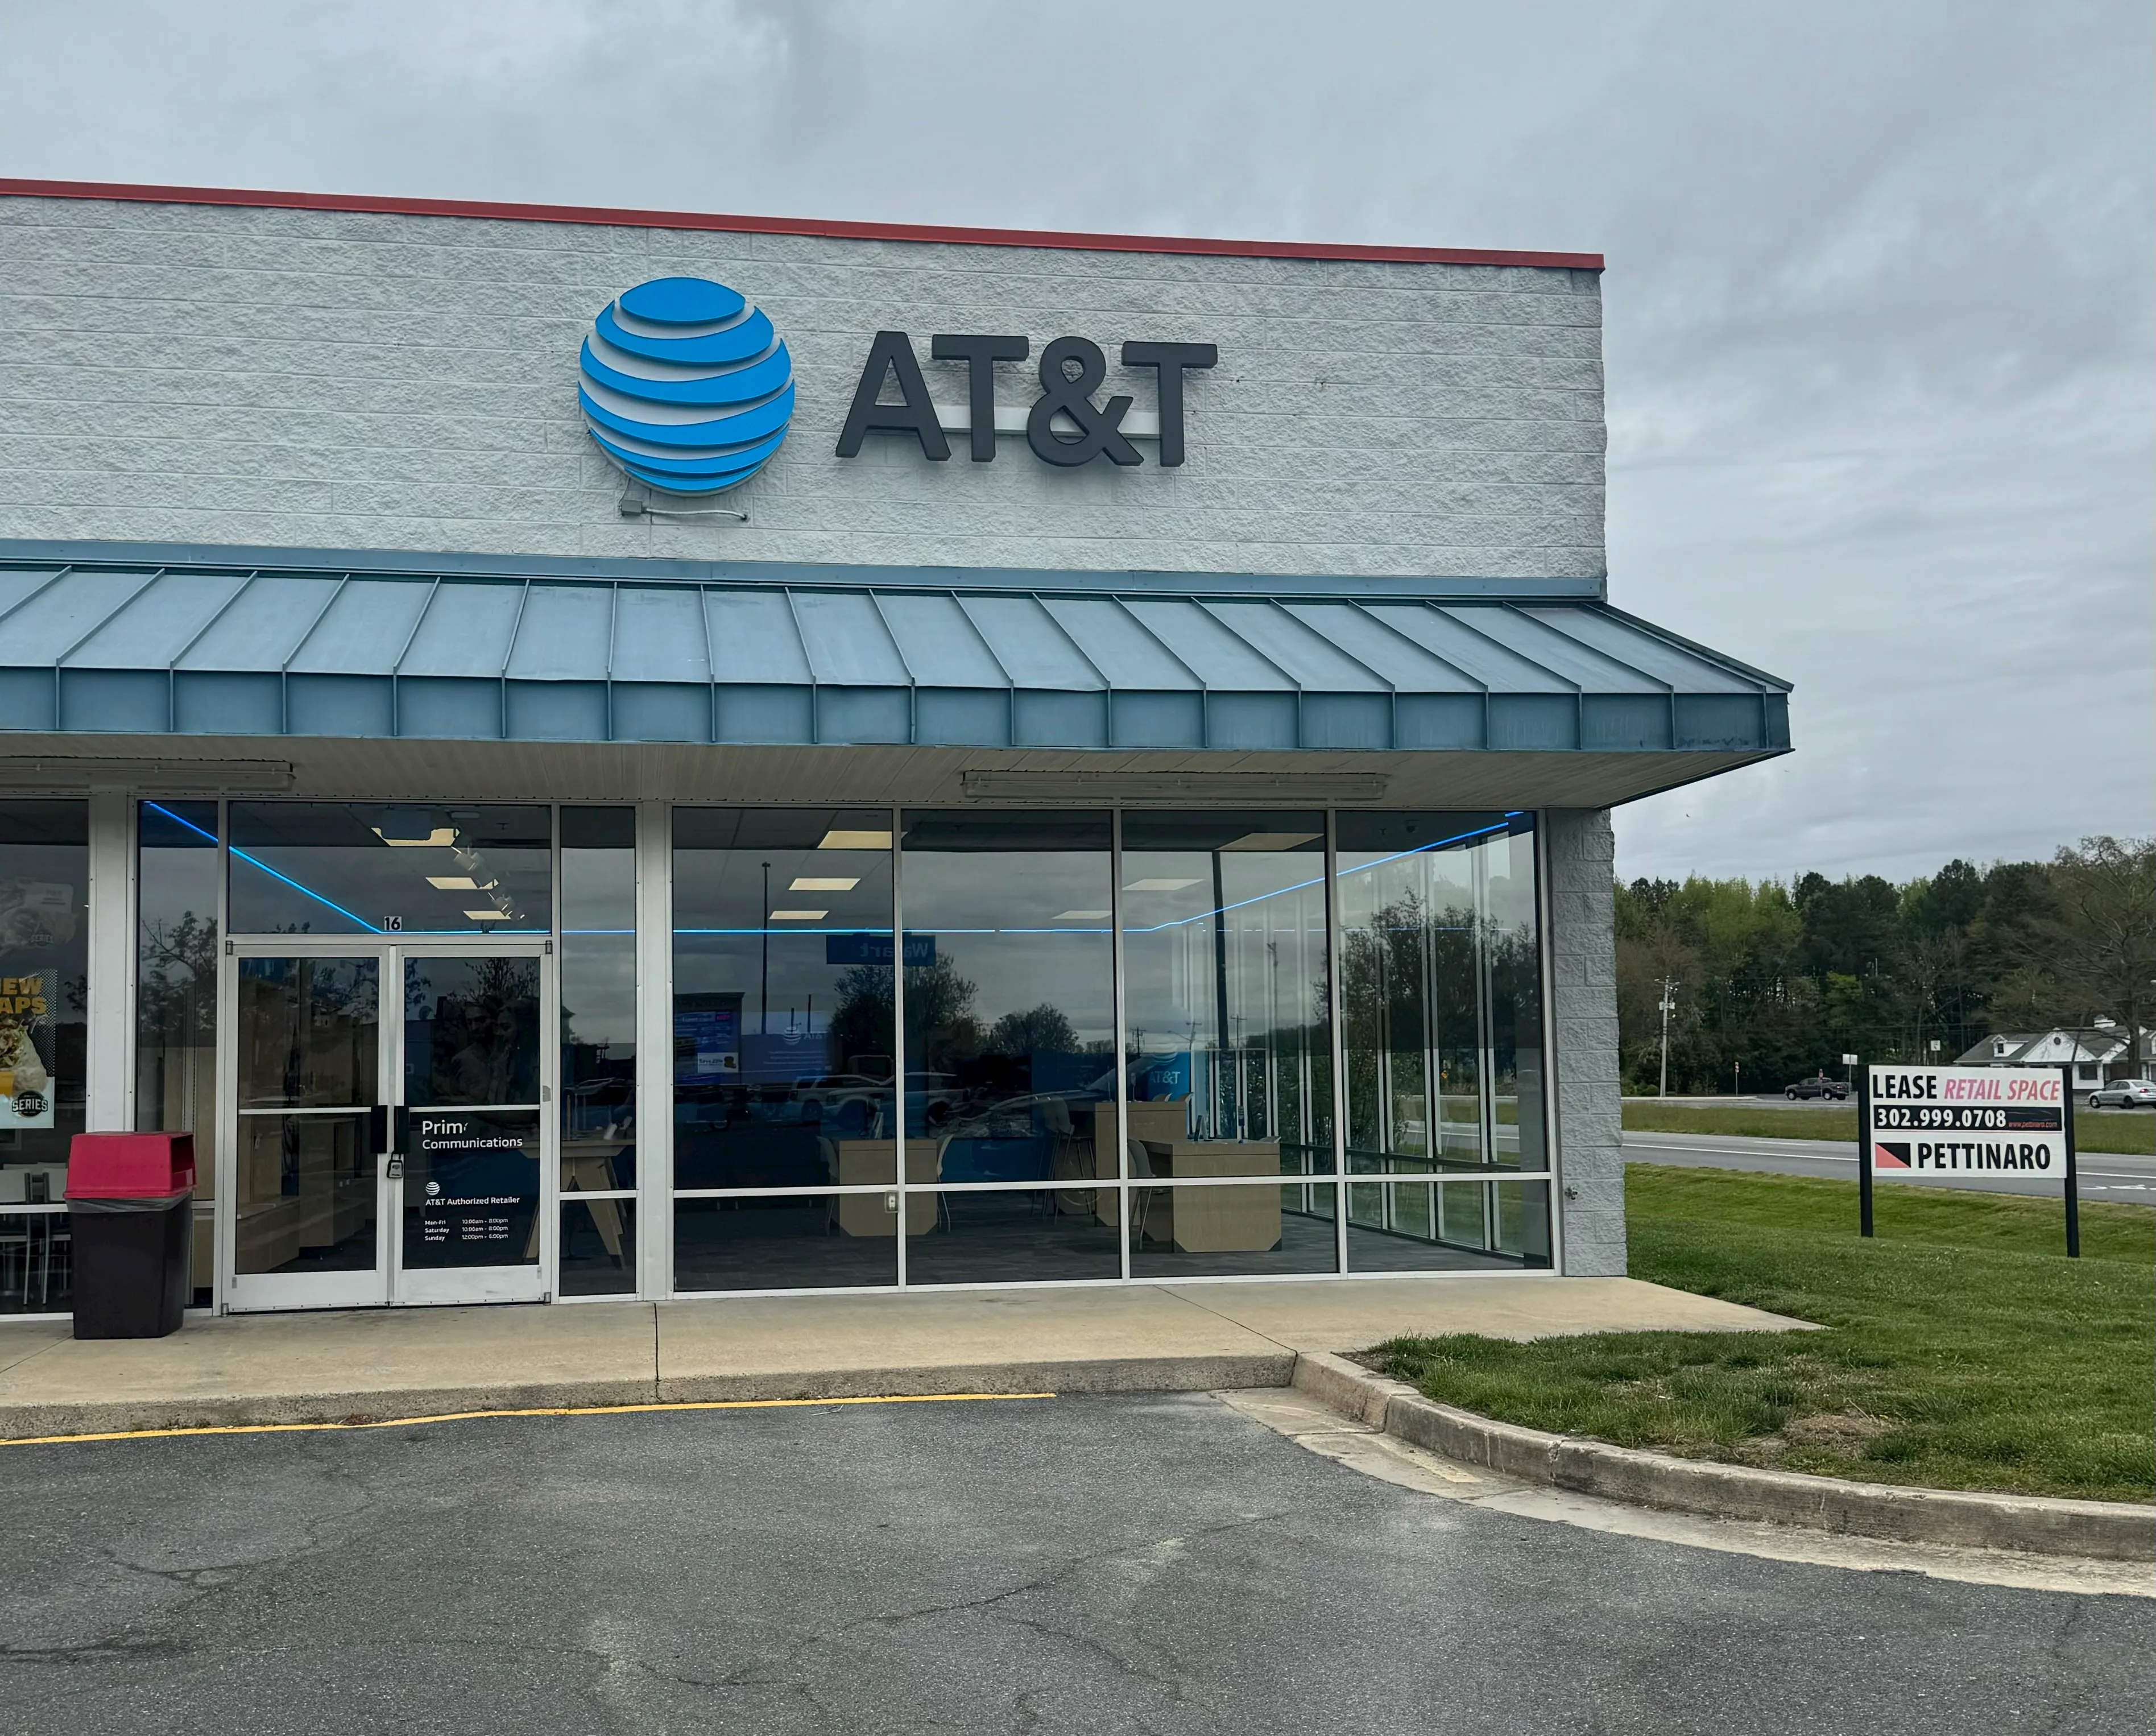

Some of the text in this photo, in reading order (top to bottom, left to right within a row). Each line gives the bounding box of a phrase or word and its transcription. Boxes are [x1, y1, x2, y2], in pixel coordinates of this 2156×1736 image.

[835, 330, 1218, 467] AT&T
[385, 917, 401, 931] 16
[0, 977, 43, 995] EW
[1149, 1070, 1181, 1085] AT&T
[1873, 1074, 2061, 1101] LEASE RETAIL SPACE
[13, 1098, 48, 1112] SERIES
[1877, 1108, 2006, 1128] 302.999.0708
[422, 1137, 523, 1149] Communications
[1918, 1143, 2051, 1170] PETTINARO
[447, 1197, 489, 1205] Authorized
